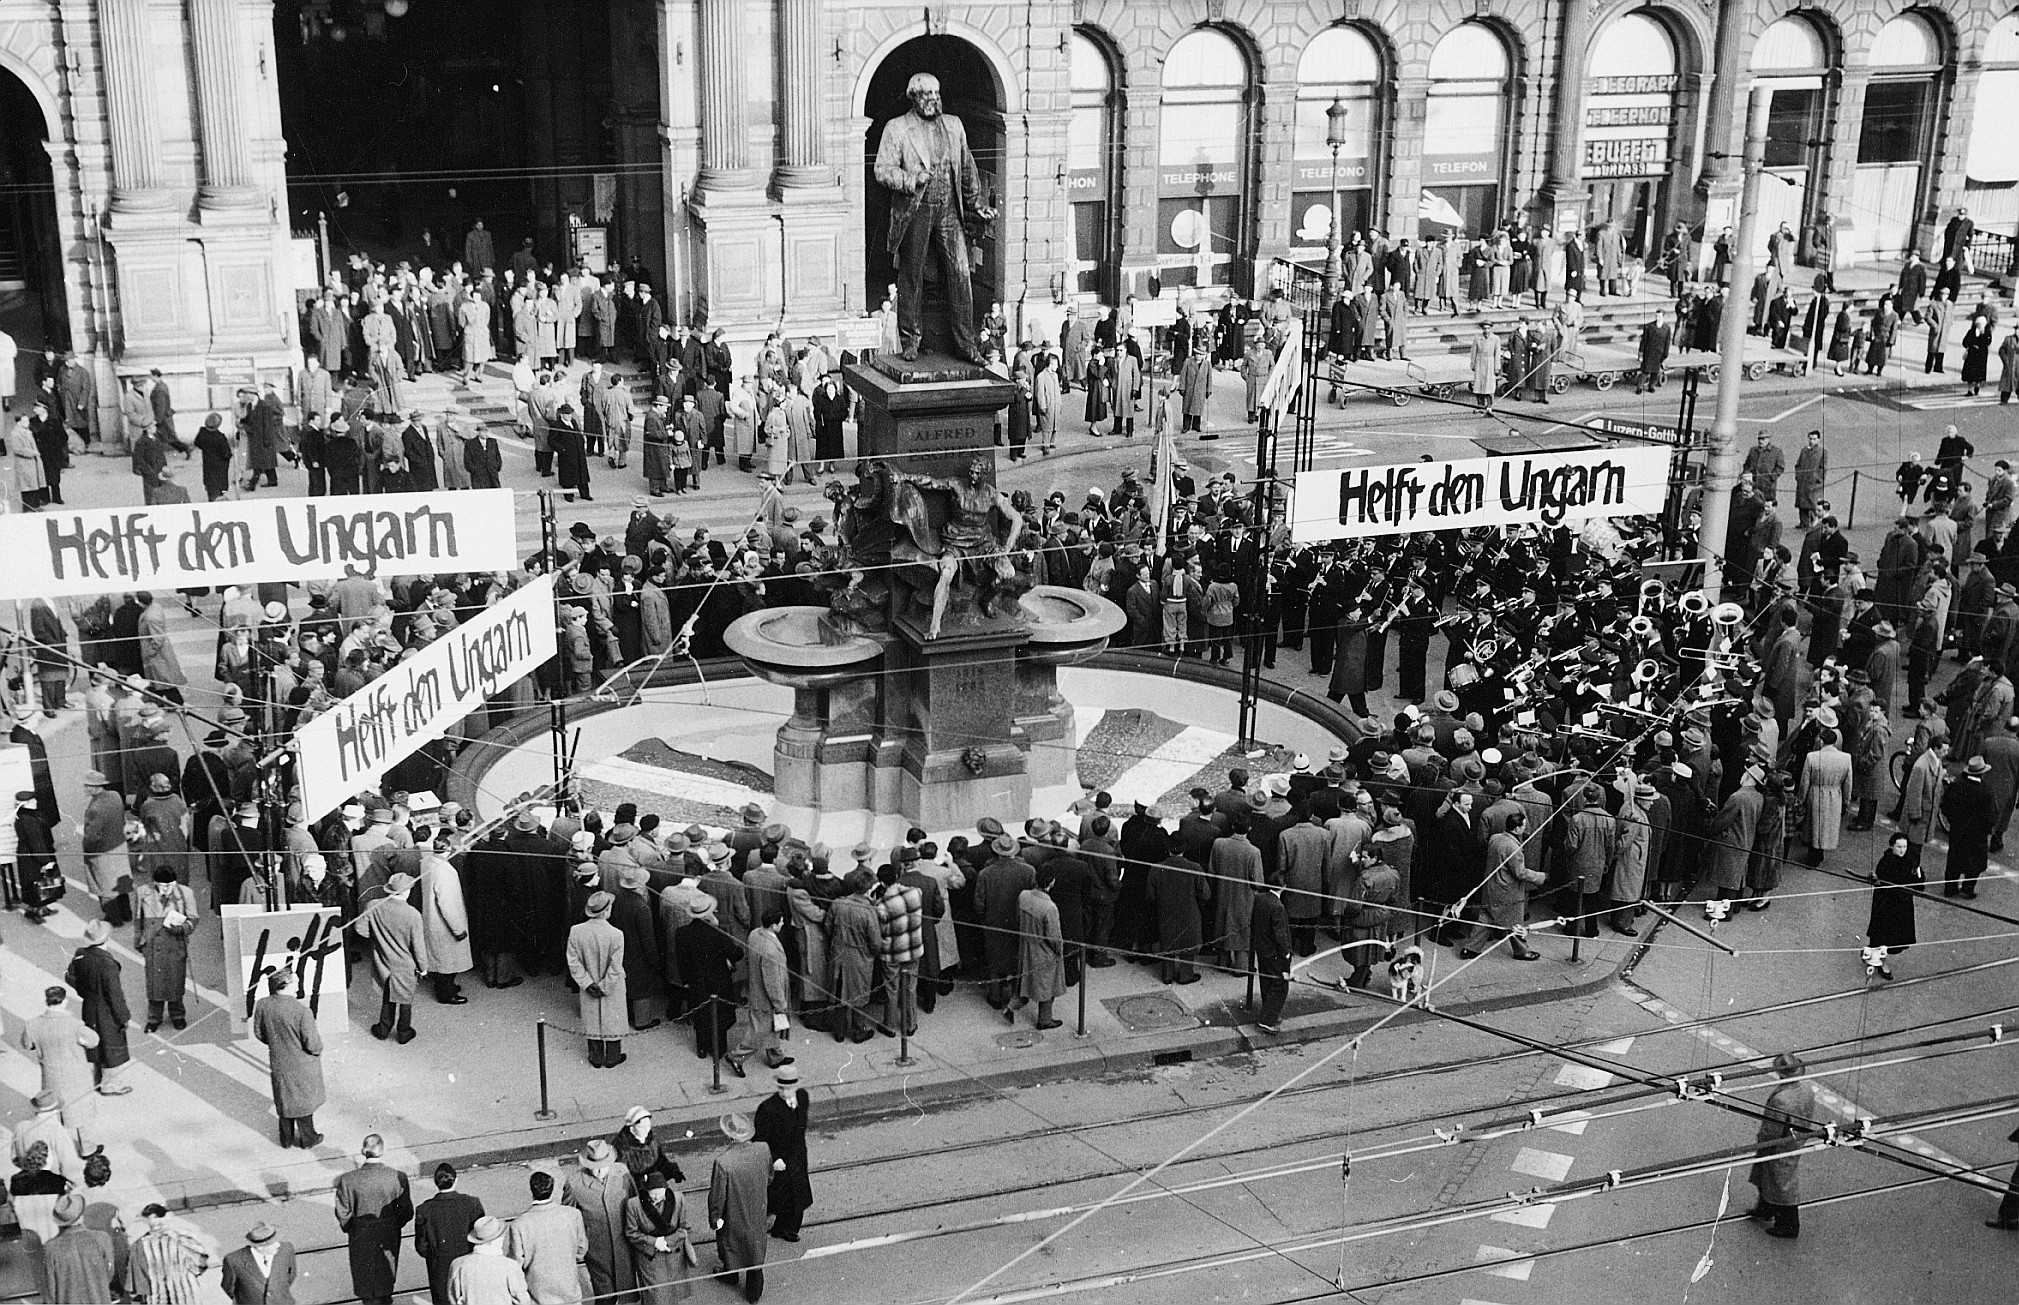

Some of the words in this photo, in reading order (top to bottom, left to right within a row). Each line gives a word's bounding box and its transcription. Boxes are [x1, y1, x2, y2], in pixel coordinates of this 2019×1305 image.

[1299, 165, 1366, 179] TELEFONO
[1432, 161, 1488, 174] TELEFON
[1162, 171, 1237, 185] TELEPHONE
[913, 426, 976, 441] ALFRED
[1338, 467, 1426, 527] Helft
[1428, 463, 1485, 516] den
[1500, 459, 1626, 527] Ungarn
[45, 512, 168, 582] Helft
[177, 509, 256, 572] den
[275, 503, 459, 580] Ungarn
[335, 683, 398, 782] Helft
[403, 667, 442, 737] den
[447, 608, 532, 702] Ungarn
